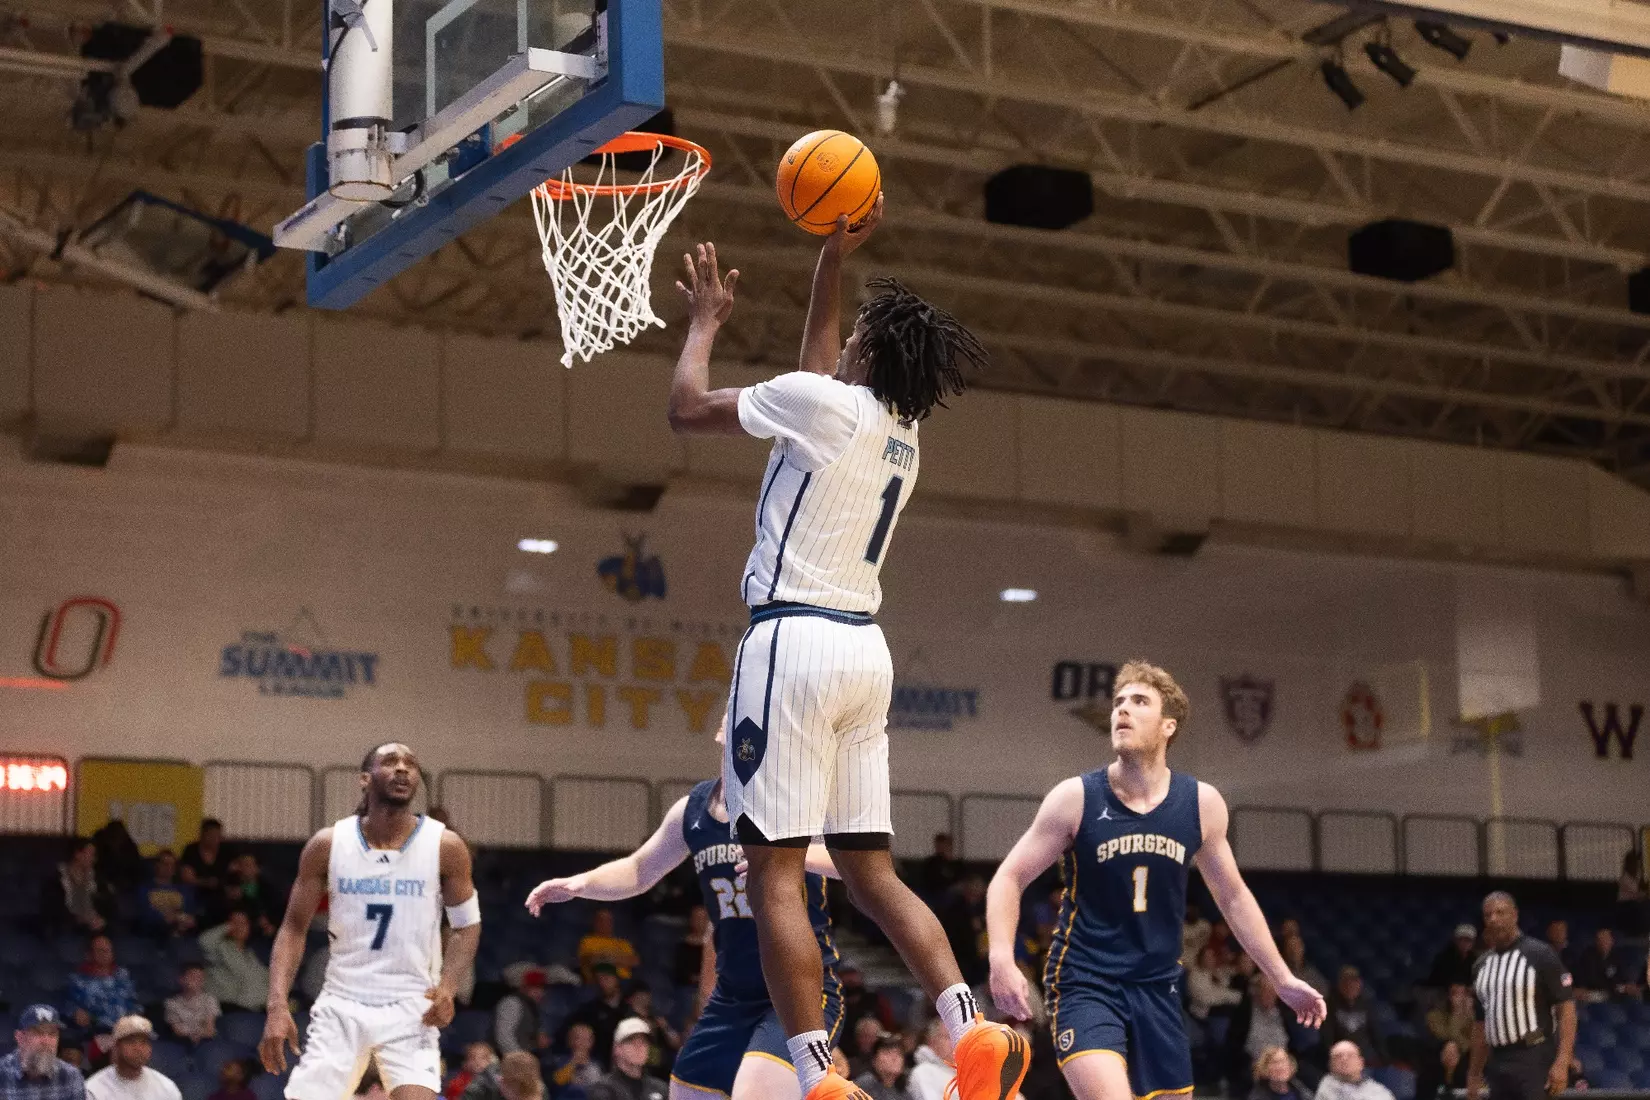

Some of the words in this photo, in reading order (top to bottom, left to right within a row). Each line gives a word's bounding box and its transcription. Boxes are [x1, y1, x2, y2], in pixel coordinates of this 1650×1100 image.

[863, 473, 904, 566] 1
[32, 597, 121, 681] O
[449, 624, 732, 684] KANSA
[220, 644, 378, 685] SUMMIT
[1052, 660, 1117, 700] OR
[525, 682, 719, 734] CITY
[1578, 702, 1645, 760] W
[1096, 833, 1187, 866] SPURGEON
[337, 877, 391, 895] KANSAS
[394, 879, 425, 897] CITY
[1131, 865, 1149, 913] 1
[366, 903, 394, 951] 7
